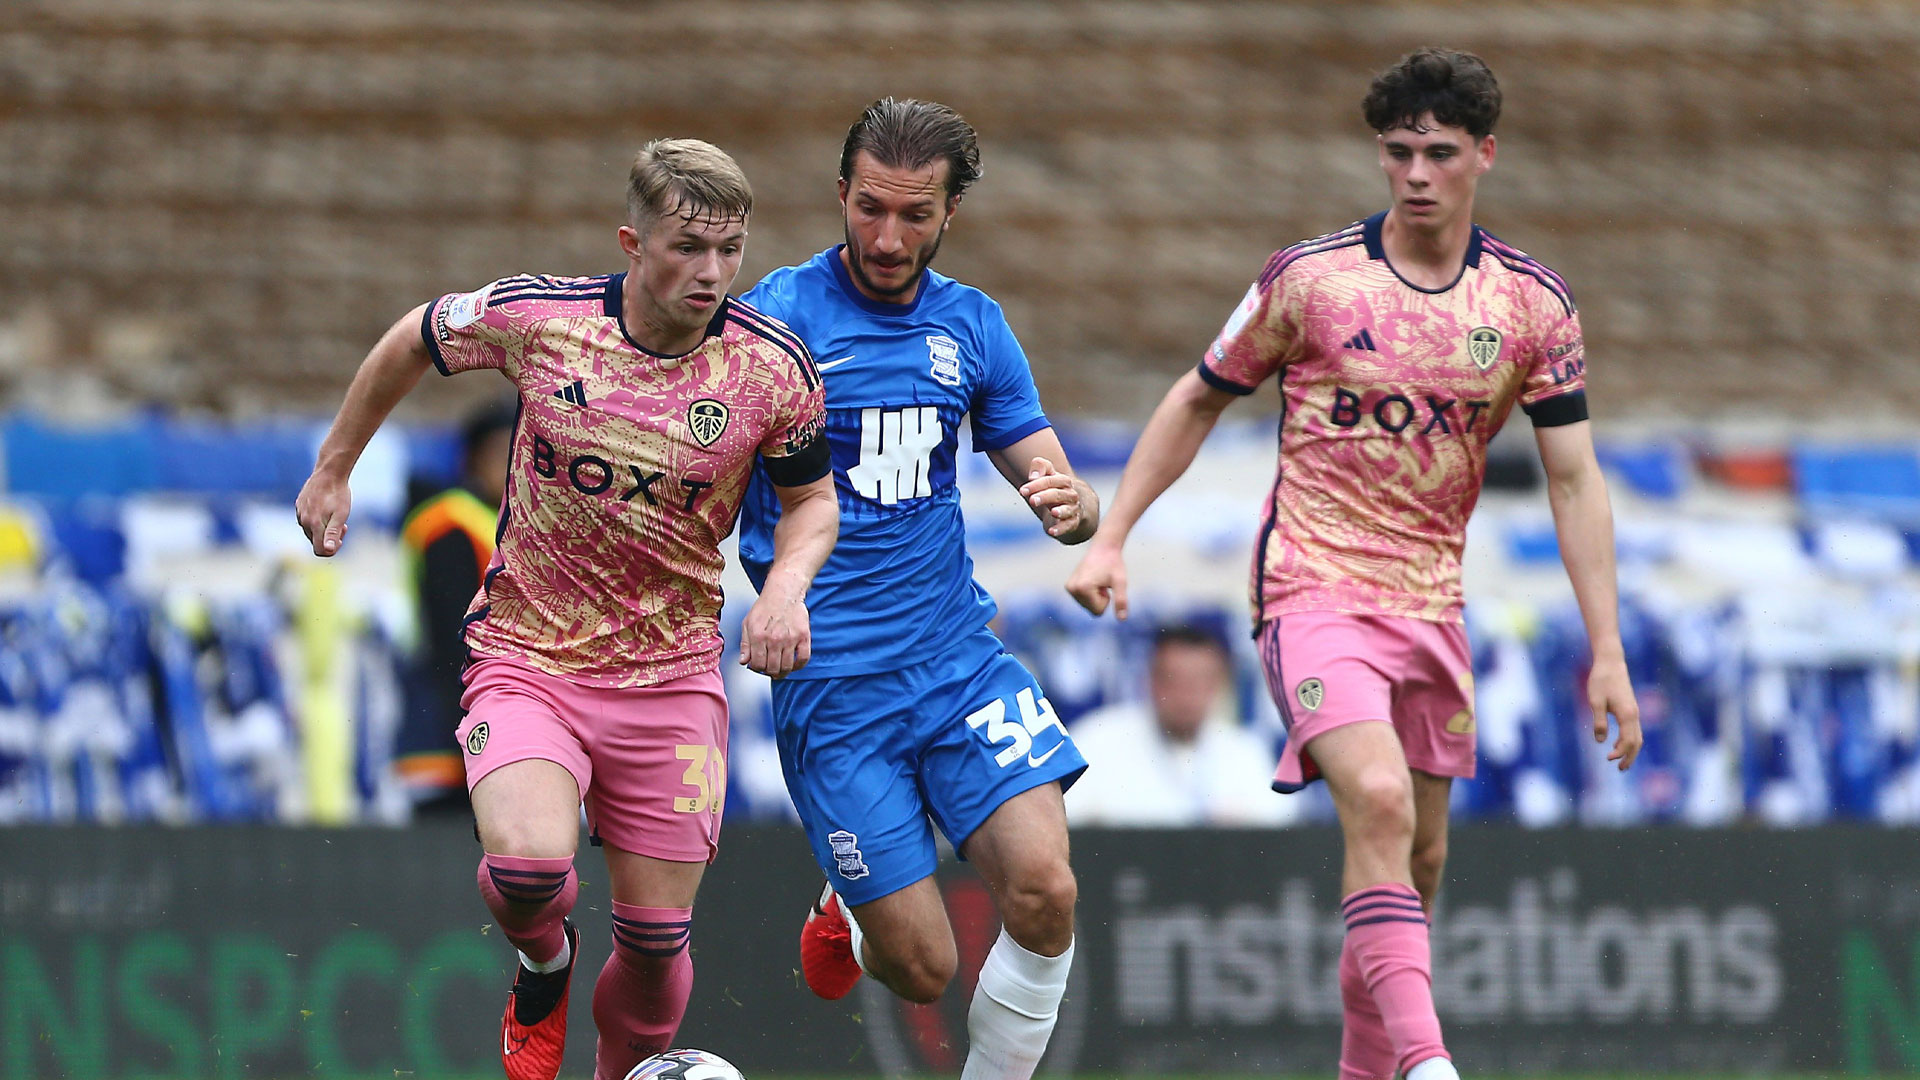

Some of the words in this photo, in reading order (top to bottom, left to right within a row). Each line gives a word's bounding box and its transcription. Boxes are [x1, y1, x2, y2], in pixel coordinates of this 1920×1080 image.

[1331, 387, 1490, 435] BOXT
[534, 433, 713, 511] BOXT
[965, 687, 1069, 768] 34
[673, 744, 725, 814] 30
[1116, 869, 1783, 1024] instations
[0, 930, 504, 1080] NSPCC
